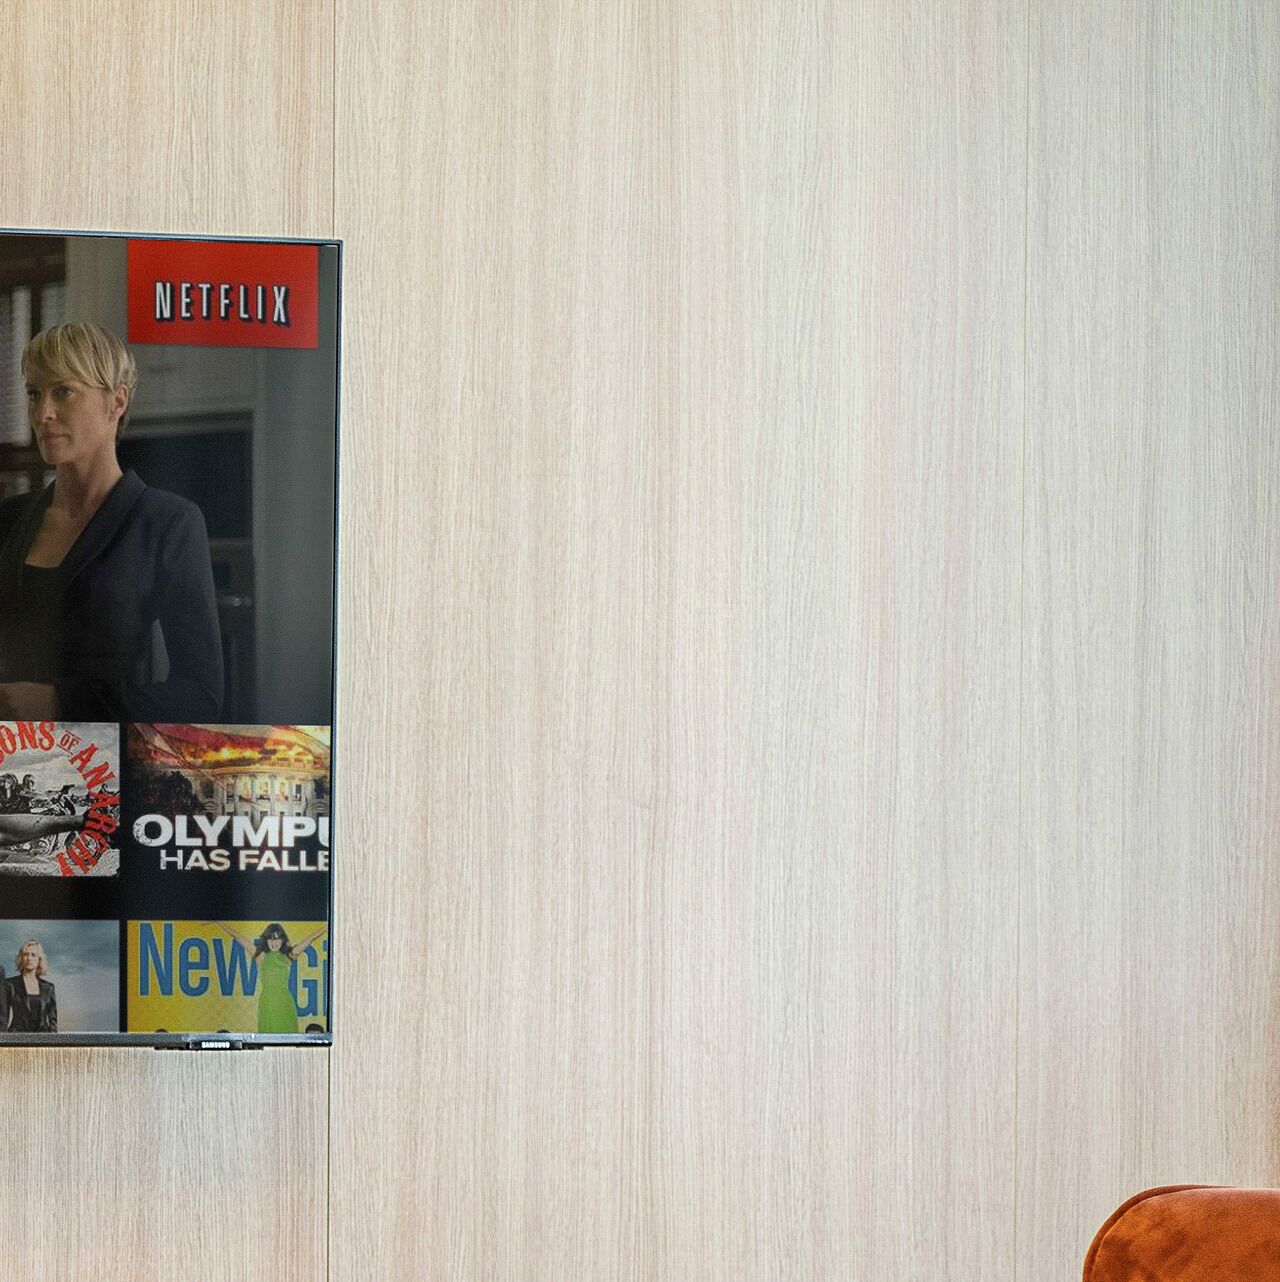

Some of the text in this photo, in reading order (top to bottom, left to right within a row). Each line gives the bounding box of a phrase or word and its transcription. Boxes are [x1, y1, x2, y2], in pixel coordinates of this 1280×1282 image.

[155, 281, 290, 325] NETFLIX
[60, 733, 79, 751] OF
[160, 849, 230, 871] HAS
[139, 922, 260, 997] New
